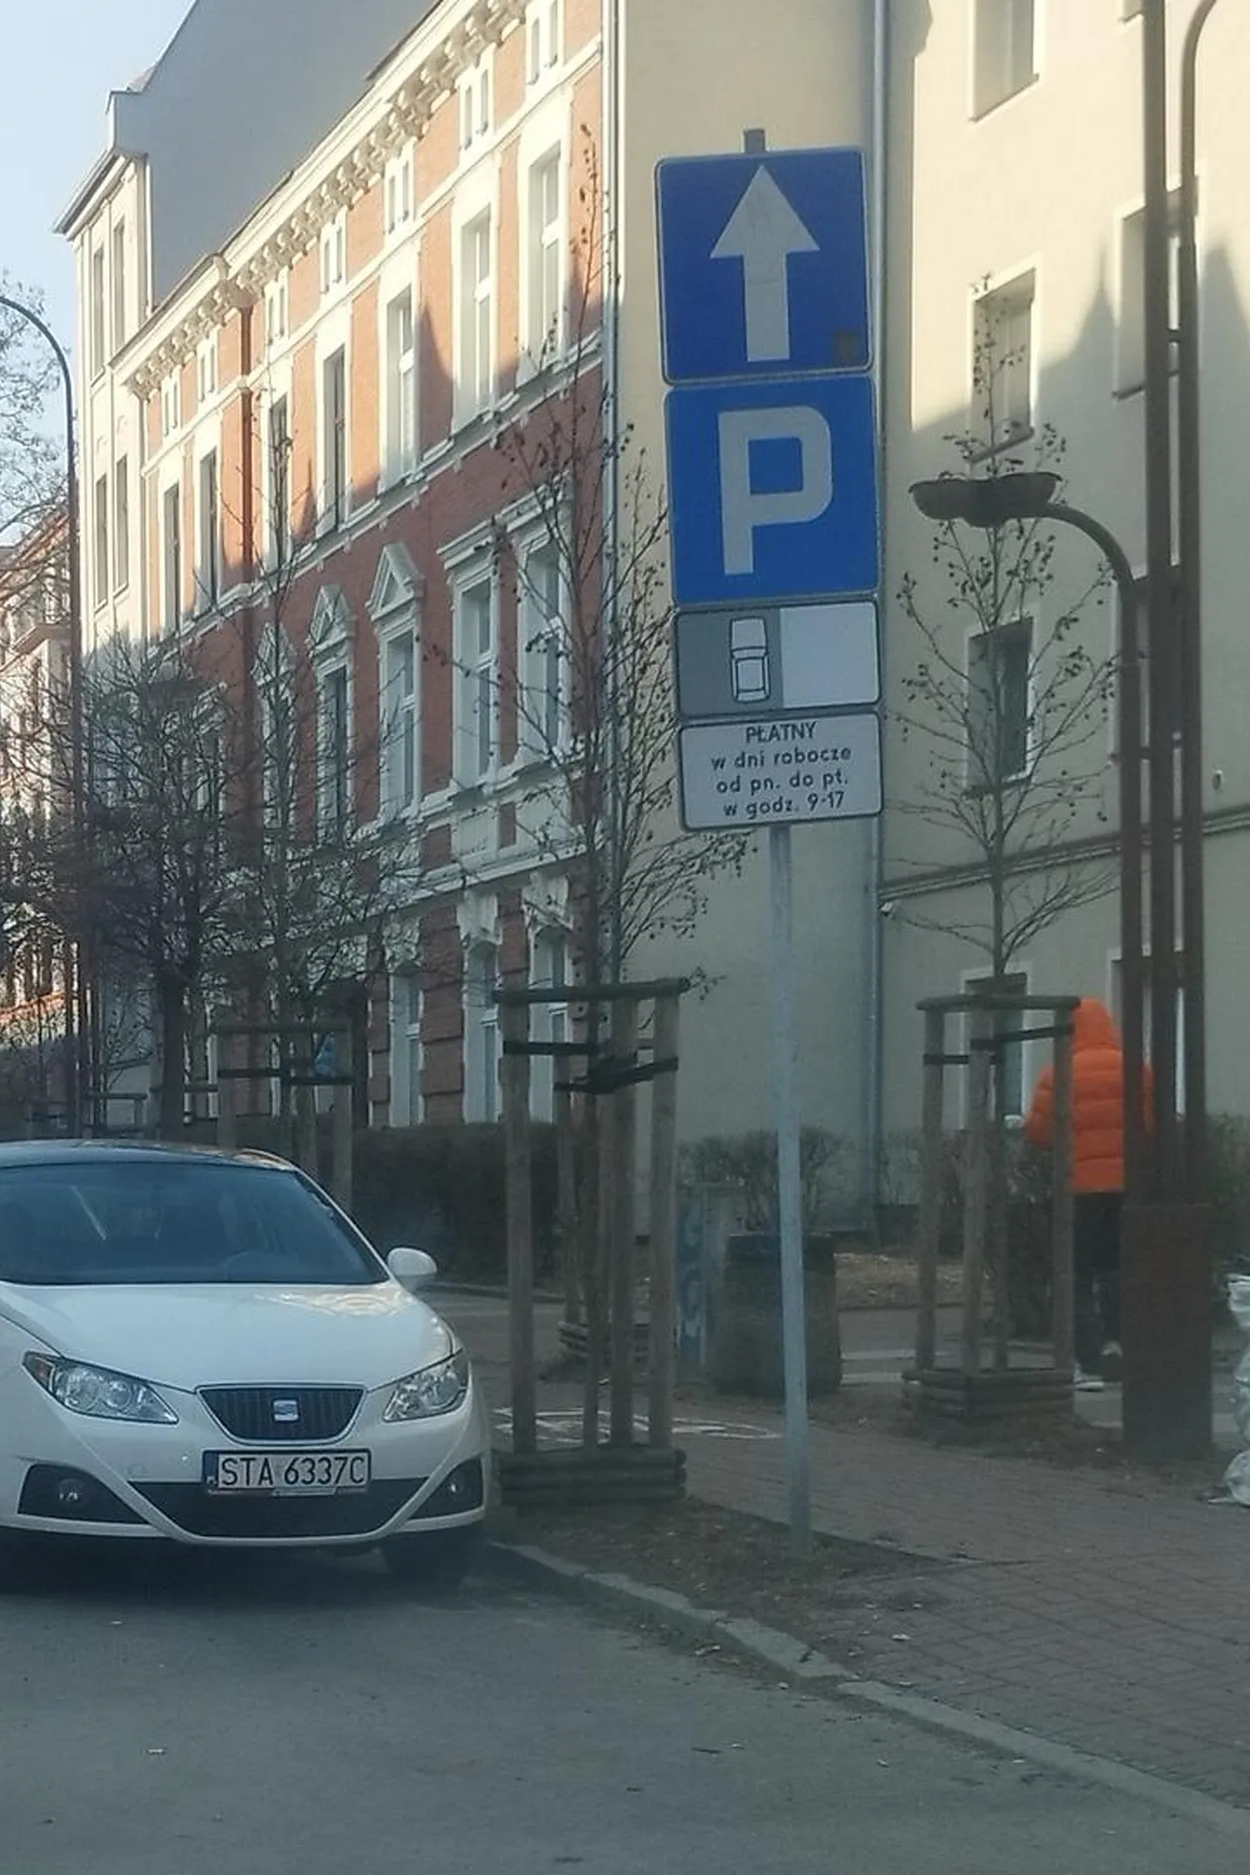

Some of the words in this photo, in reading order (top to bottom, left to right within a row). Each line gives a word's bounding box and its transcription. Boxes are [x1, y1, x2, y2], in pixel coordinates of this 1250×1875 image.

[718, 405, 833, 575] P
[745, 721, 818, 743] PŁATNY
[710, 758, 726, 770] w
[734, 750, 765, 768] dni
[774, 745, 851, 765] robocze
[716, 774, 741, 793] od
[751, 778, 780, 796] pn.
[790, 770, 814, 787] do
[823, 768, 848, 789] pt.
[723, 804, 738, 816] w
[746, 795, 799, 820] godz.
[807, 791, 845, 811] 9-17
[221, 1457, 274, 1486] STA
[284, 1457, 365, 1485] 6337C
